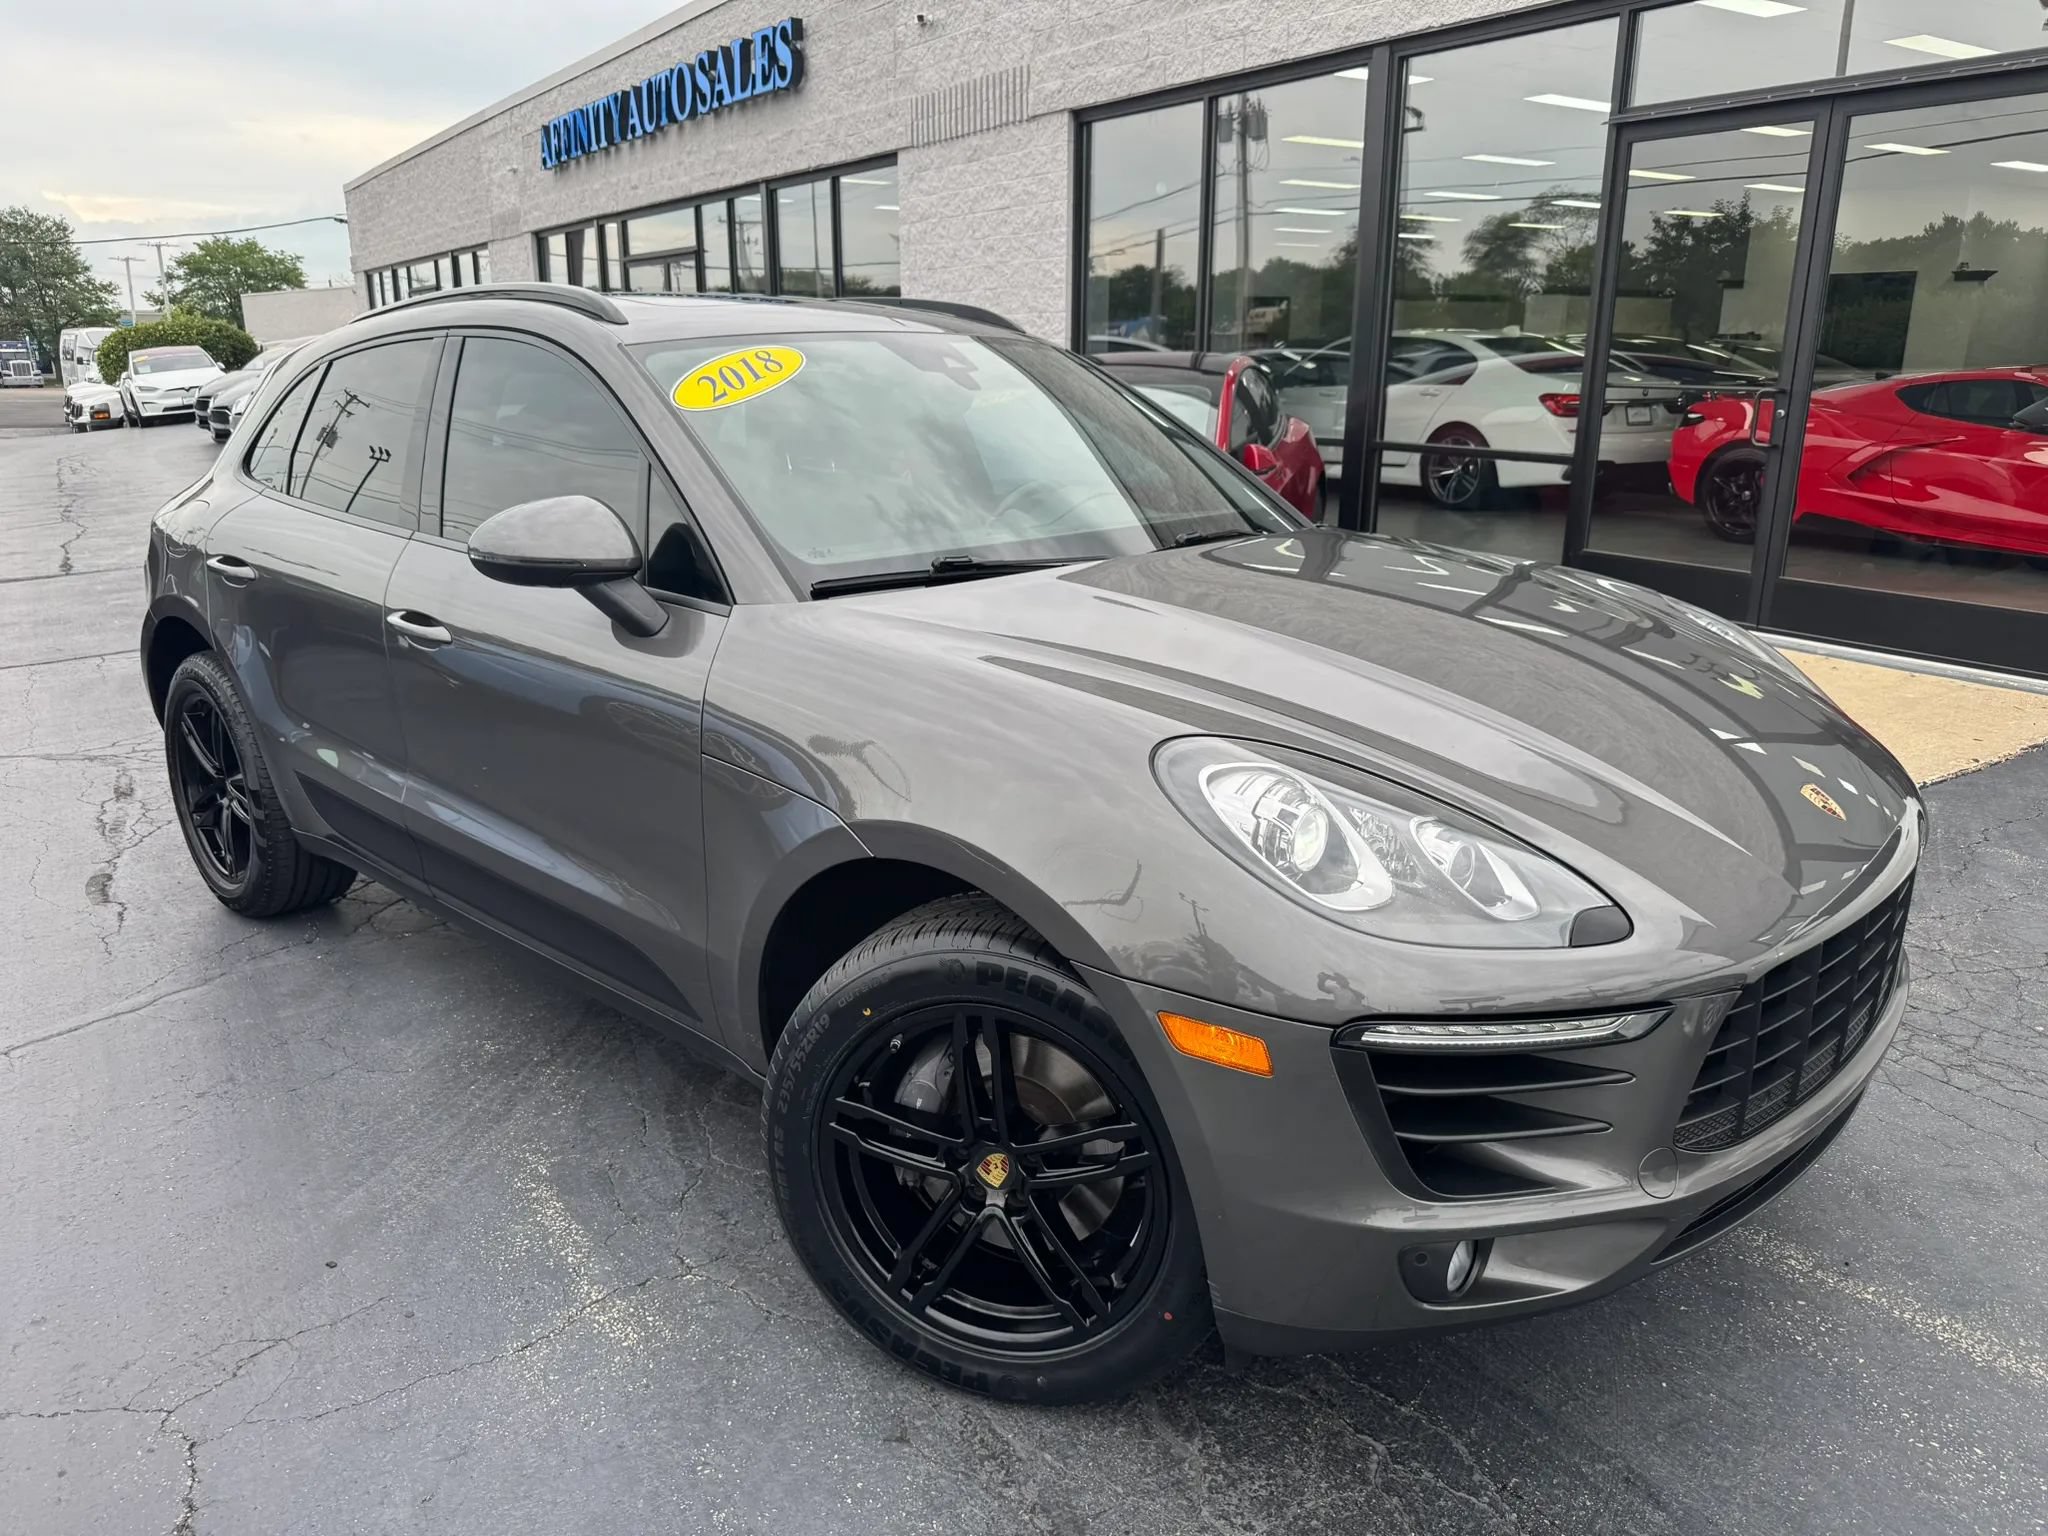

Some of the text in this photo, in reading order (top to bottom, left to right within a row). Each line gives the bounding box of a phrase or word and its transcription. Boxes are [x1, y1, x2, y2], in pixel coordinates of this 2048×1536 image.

[541, 17, 796, 170] AFFINITY AUTO SALES
[697, 350, 784, 402] 2018
[776, 1012, 832, 1115] 235/55ZR19
